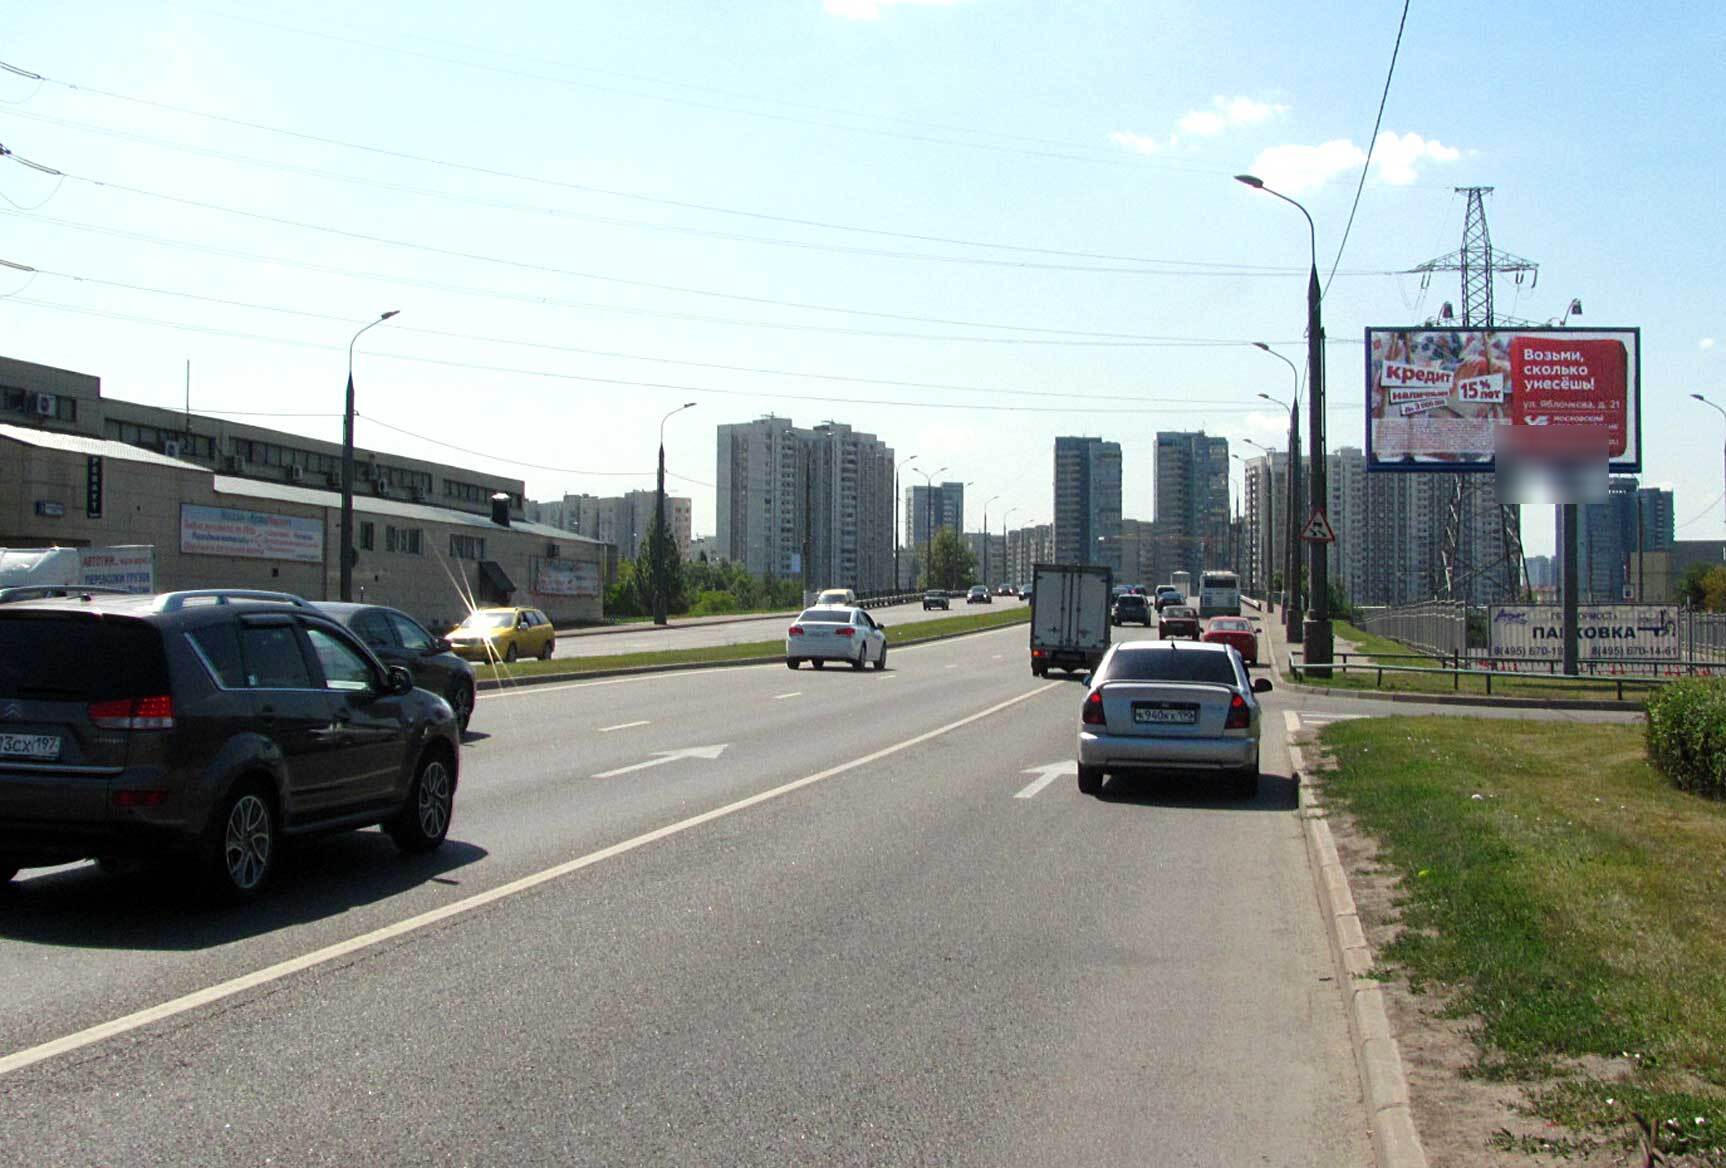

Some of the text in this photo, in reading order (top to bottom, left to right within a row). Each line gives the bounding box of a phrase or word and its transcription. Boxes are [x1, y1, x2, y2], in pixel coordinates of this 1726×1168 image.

[1524, 348, 1584, 362] Возьми,
[1524, 365, 1588, 375] сколько
[1461, 382, 1478, 399] 15
[1524, 377, 1595, 392] унесёшь!
